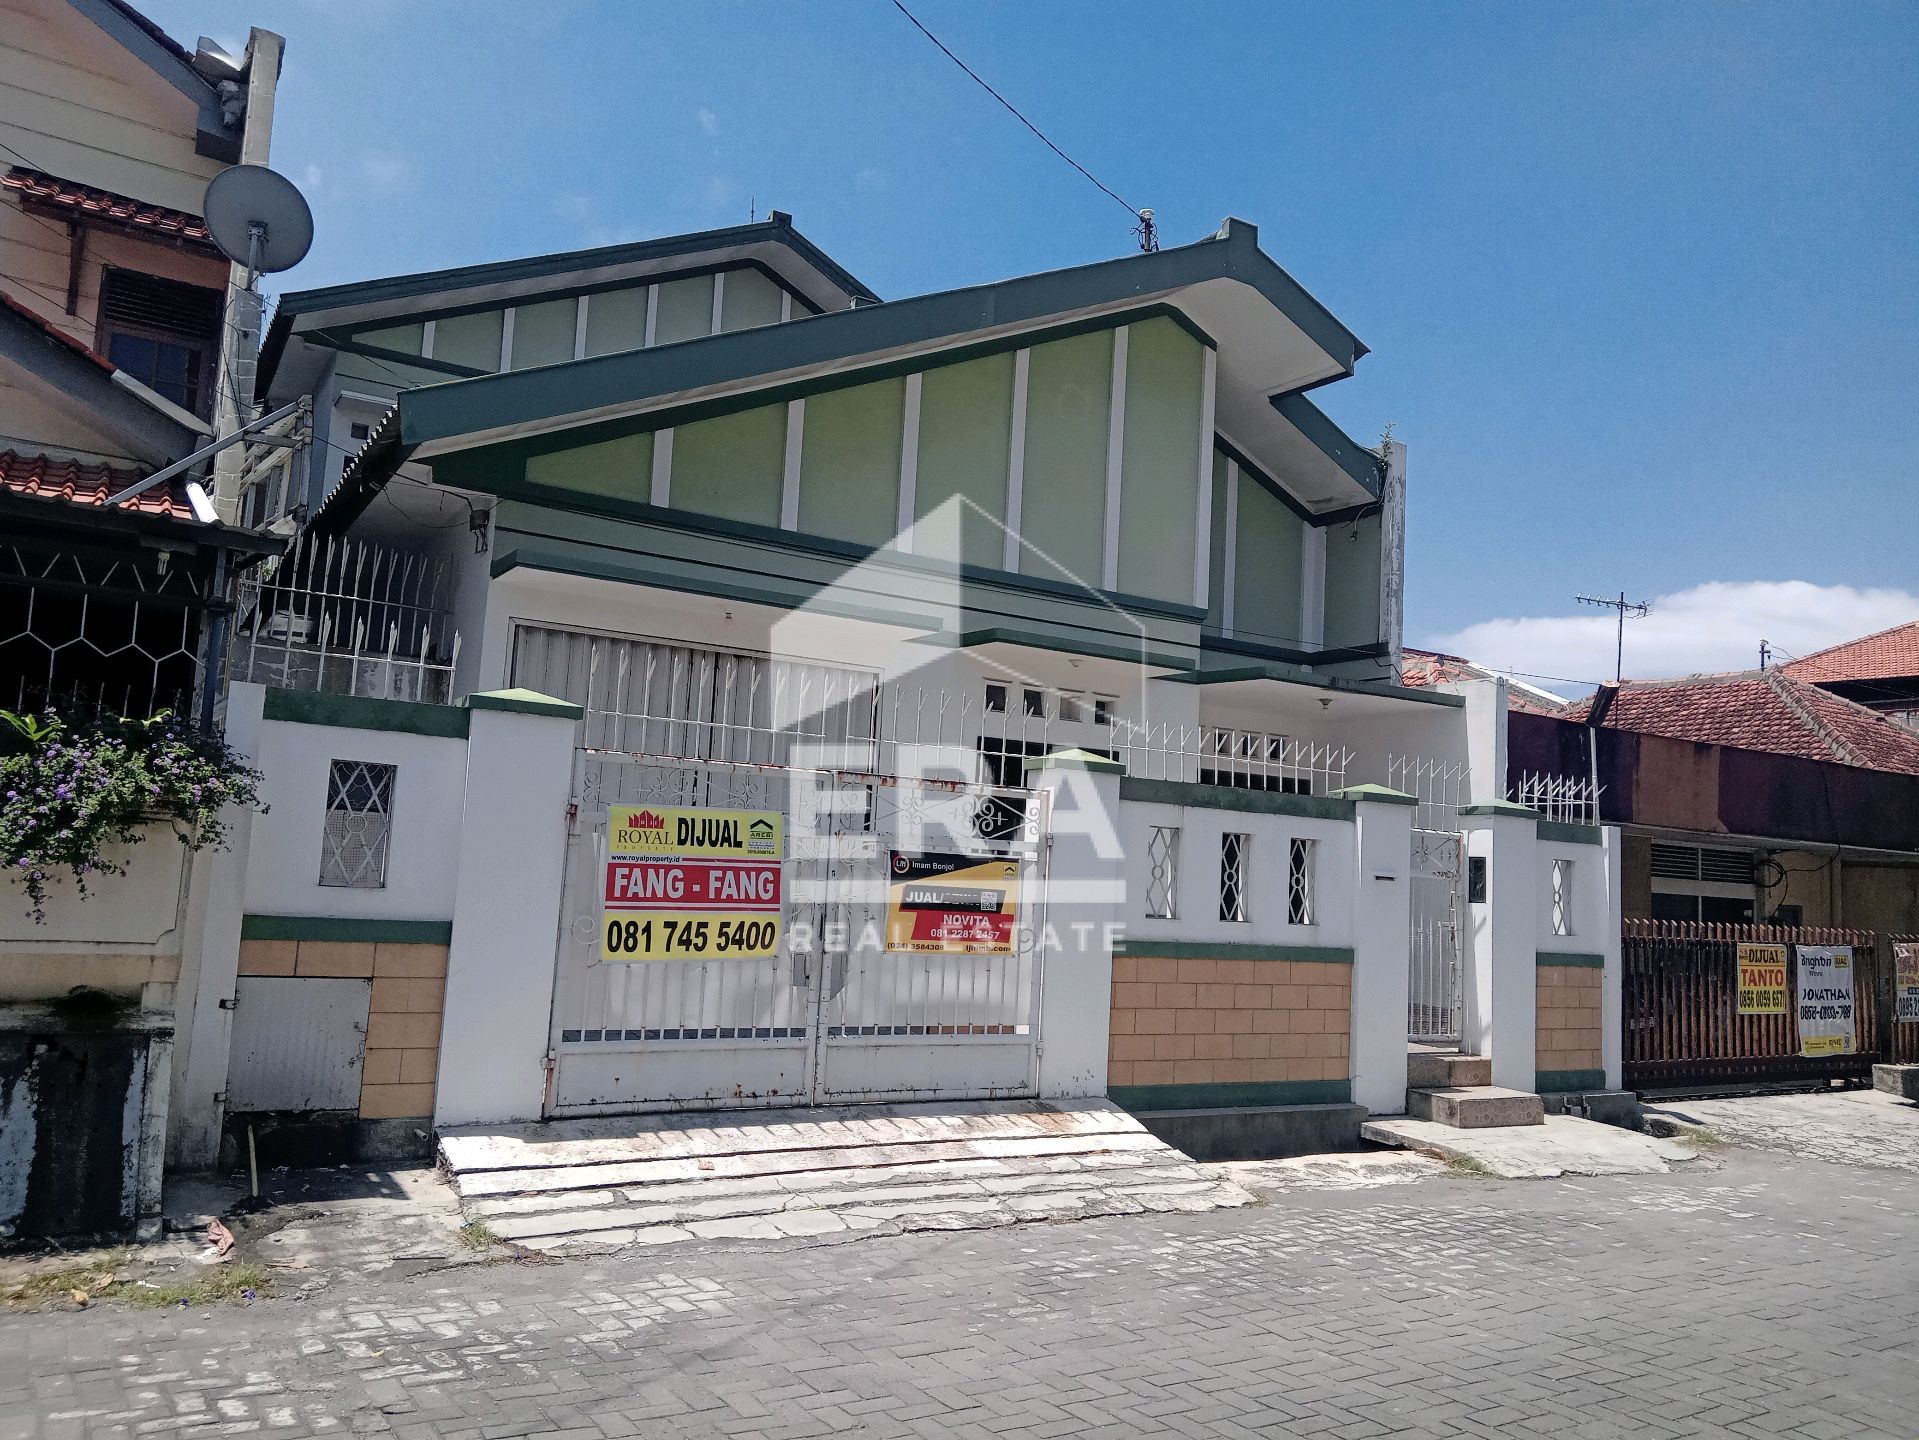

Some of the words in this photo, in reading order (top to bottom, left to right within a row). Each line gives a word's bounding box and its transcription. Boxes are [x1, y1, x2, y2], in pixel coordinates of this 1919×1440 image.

[617, 829, 674, 845] ROYAL
[677, 817, 743, 848] DIJUAL
[611, 855, 680, 863] www.royalproperty.id
[912, 861, 931, 869] Imam
[614, 867, 684, 899] FANG
[692, 884, 701, 892] -
[708, 870, 774, 900] FANG
[943, 915, 990, 927] NOVITA
[607, 920, 651, 952] 081
[663, 920, 709, 952] 745
[716, 921, 776, 952] 5400
[930, 929, 948, 938] 081
[951, 930, 973, 939] 2287
[976, 930, 1000, 940] 2457
[1749, 949, 1780, 963] DIJUAL
[1741, 969, 1784, 986] TANTO
[1803, 988, 1850, 1000] JONATHAN
